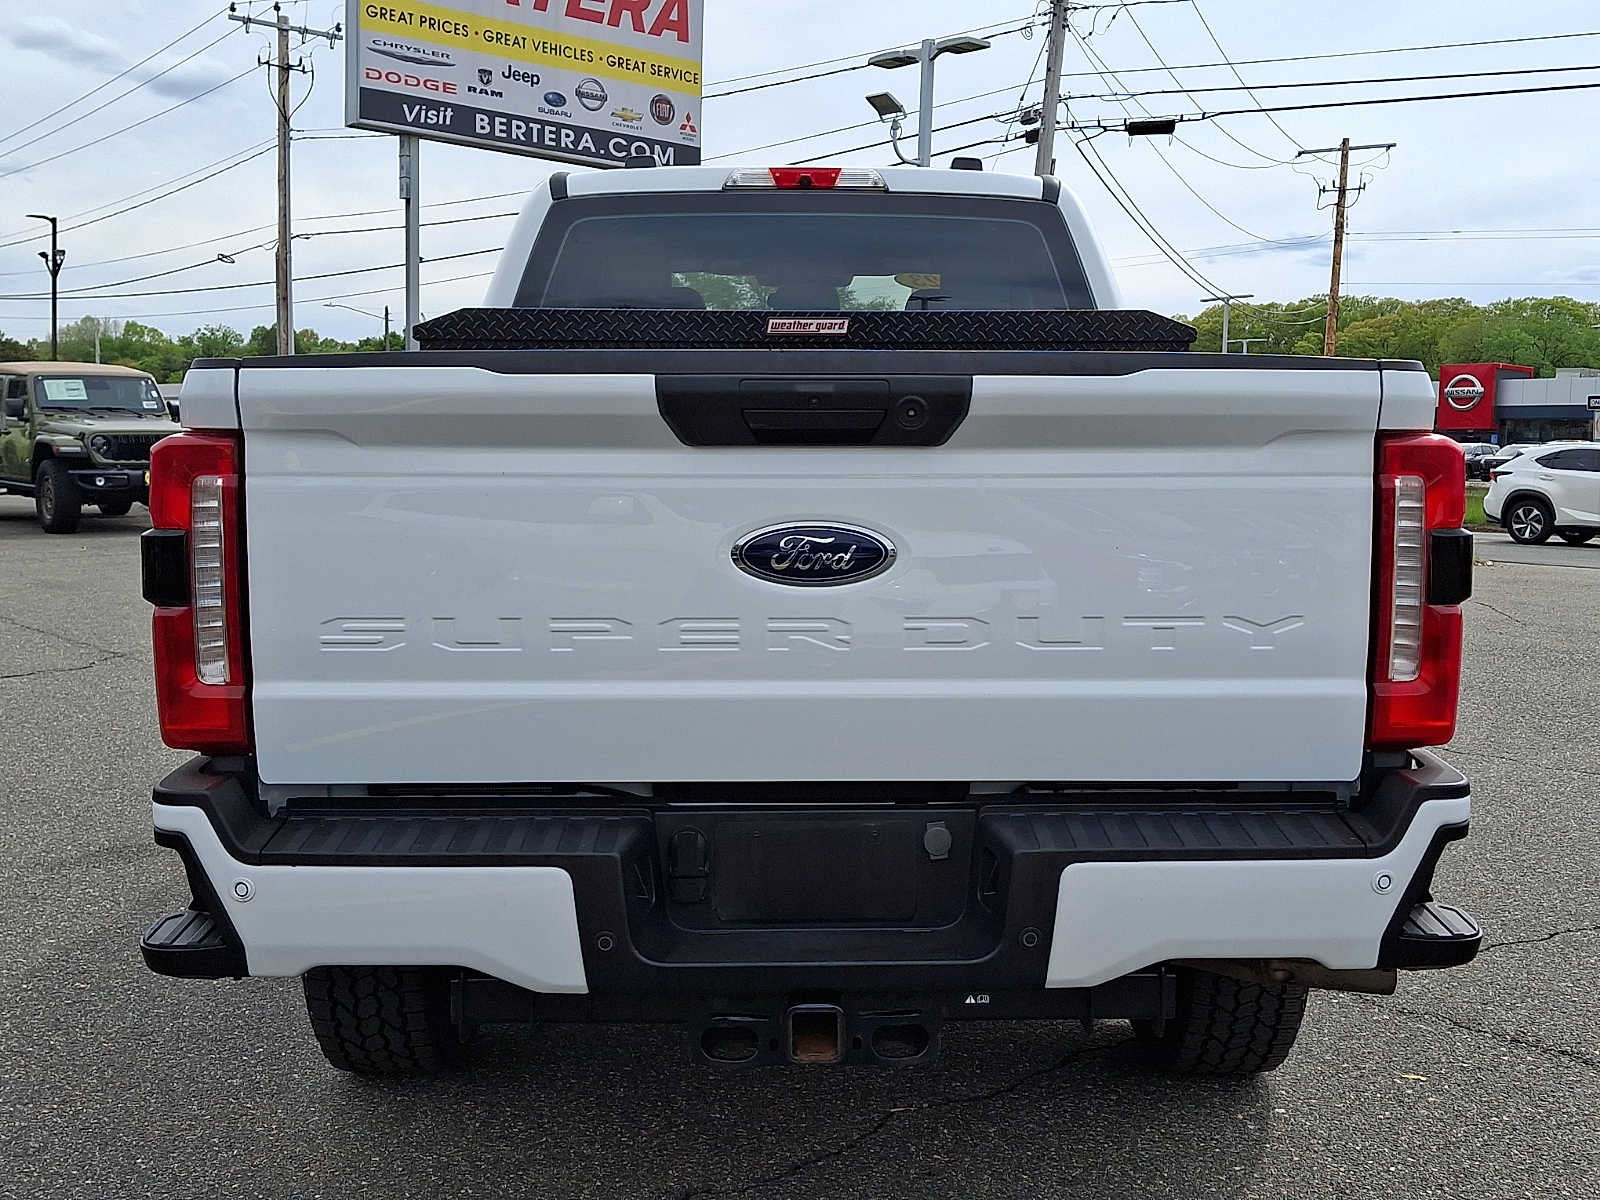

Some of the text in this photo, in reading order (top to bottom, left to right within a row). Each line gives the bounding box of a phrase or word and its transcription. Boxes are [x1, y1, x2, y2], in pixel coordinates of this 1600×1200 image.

[366, 5, 699, 85] GREAT PRICES GREAT VEHICLES GREAT SERVICE
[372, 39, 451, 60] CHRYSLER
[365, 67, 458, 95] DODGE
[502, 65, 540, 87] Jeep
[467, 85, 503, 98] RAM
[578, 89, 605, 100] NISSAN
[538, 106, 572, 118] SUBARU
[656, 102, 670, 118] FIAT
[402, 104, 673, 165] Visit BERTERA.COM
[612, 121, 643, 131] CHEVROLET
[771, 320, 846, 331] weather guard
[770, 535, 857, 570] Ford
[320, 616, 1304, 651] SUPER DUTY
